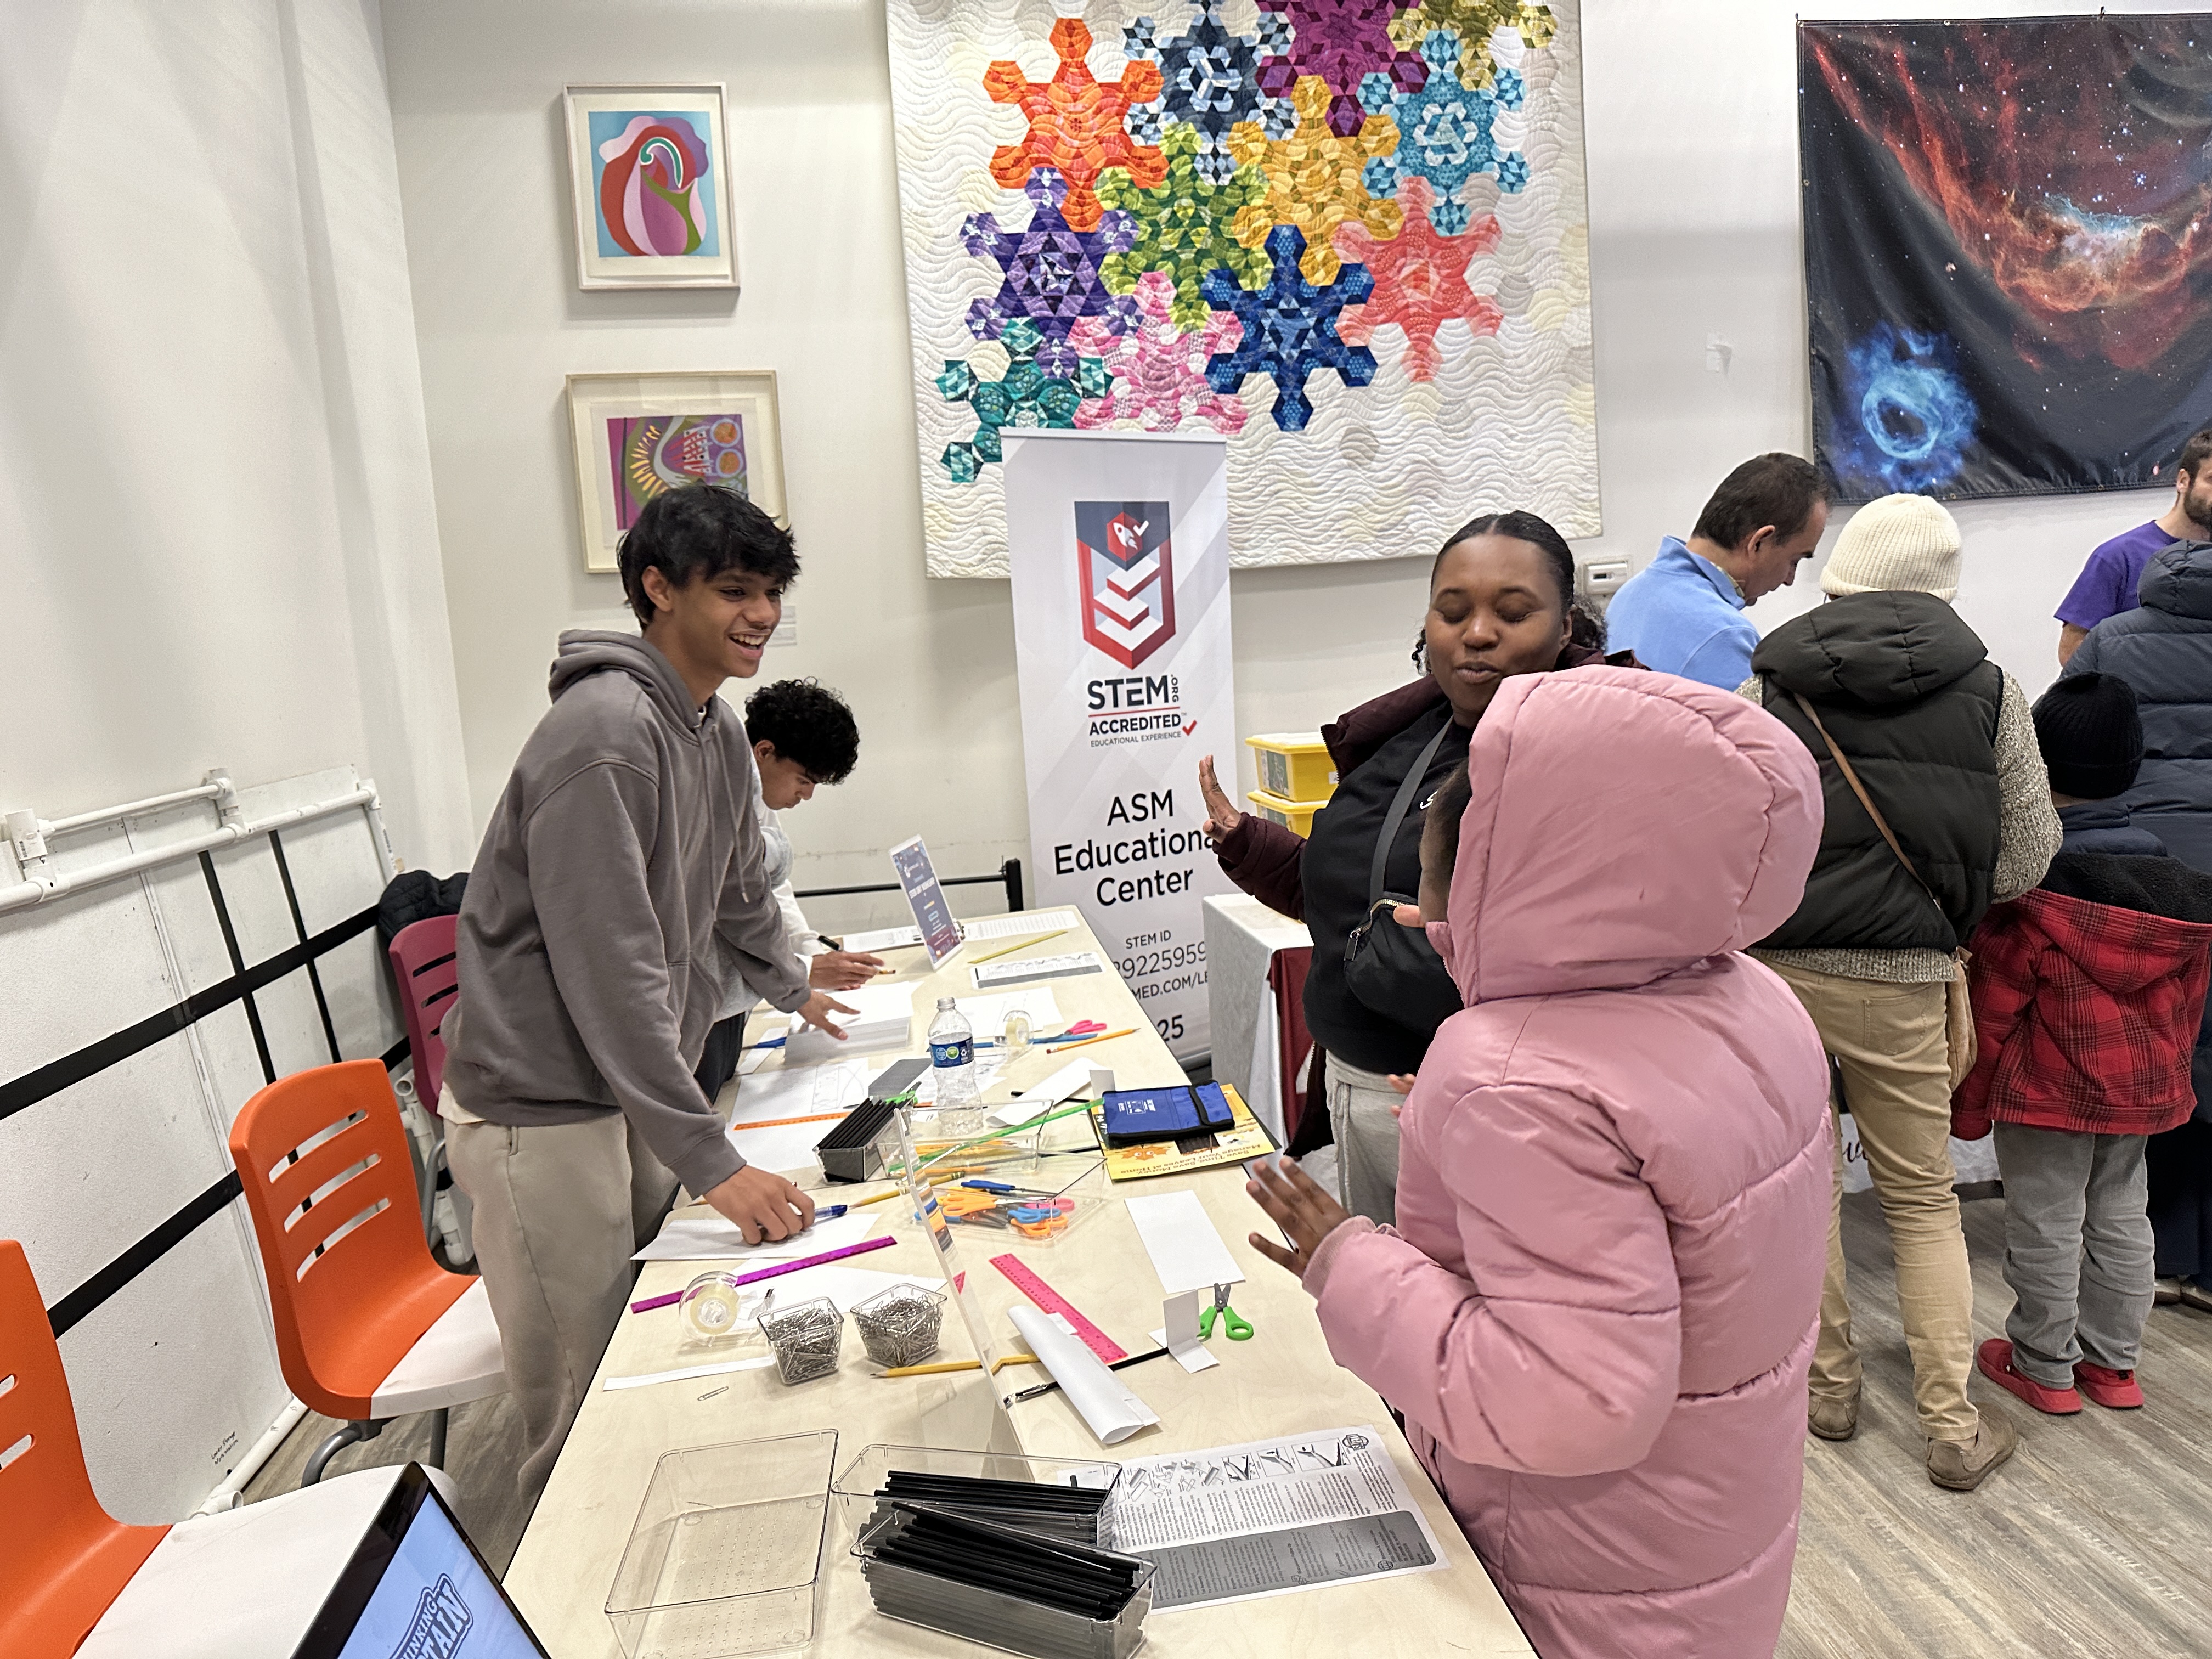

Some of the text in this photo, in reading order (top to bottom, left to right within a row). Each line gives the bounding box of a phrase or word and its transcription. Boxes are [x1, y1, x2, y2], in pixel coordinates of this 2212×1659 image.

[1087, 675, 1169, 709] STEM
[1090, 714, 1181, 736] ACCREDITED
[1091, 731, 1181, 747] EDUCATIONAL EXPERIENCE
[1107, 789, 1173, 826] ASM
[1097, 869, 1193, 906] Center
[1126, 930, 1171, 949] STEM ID
[417, 1582, 469, 1659] TAIN
